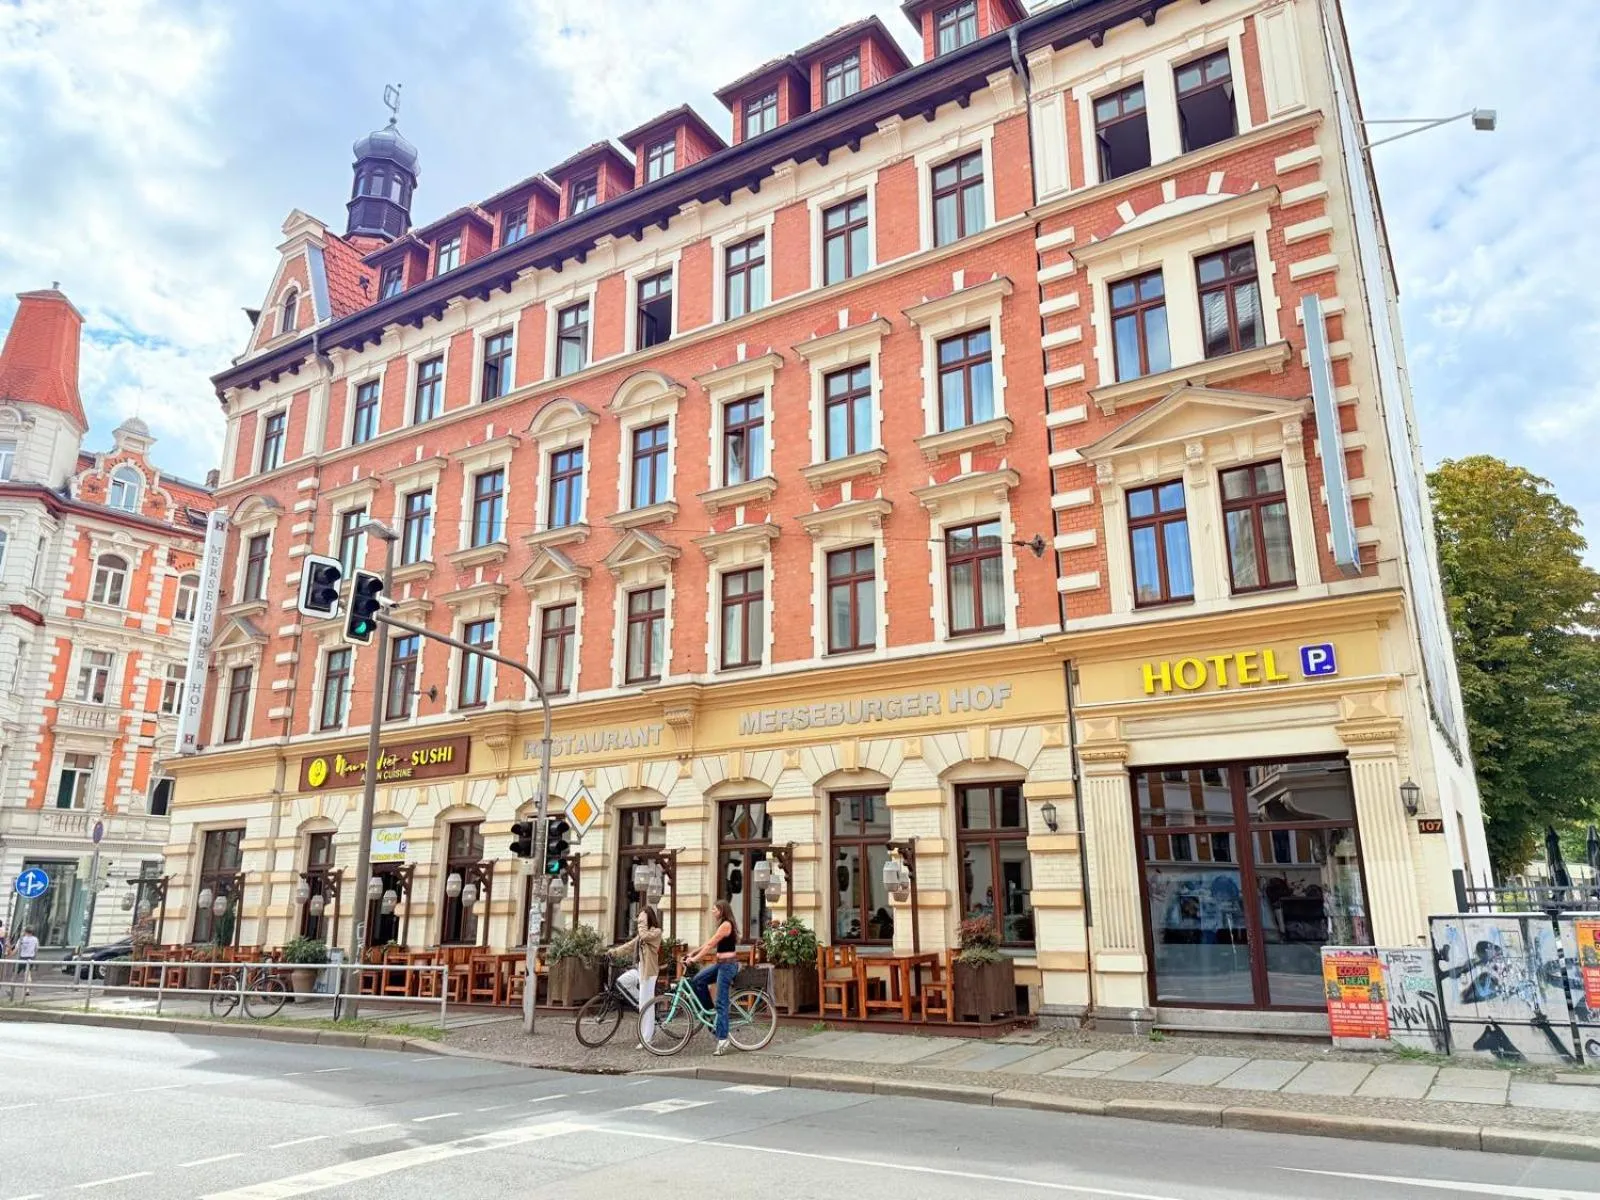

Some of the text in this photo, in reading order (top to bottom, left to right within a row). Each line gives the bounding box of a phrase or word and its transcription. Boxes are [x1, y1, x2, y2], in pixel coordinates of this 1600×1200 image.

[189, 544, 222, 717] MERSEBURGER HOF
[1142, 648, 1289, 694] HOTEL
[1307, 648, 1327, 672] P
[739, 682, 1012, 735] MERSEBURGER HOF
[411, 746, 453, 766] SUSHI
[383, 768, 413, 780] CUISINE
[1419, 820, 1442, 832] 107
